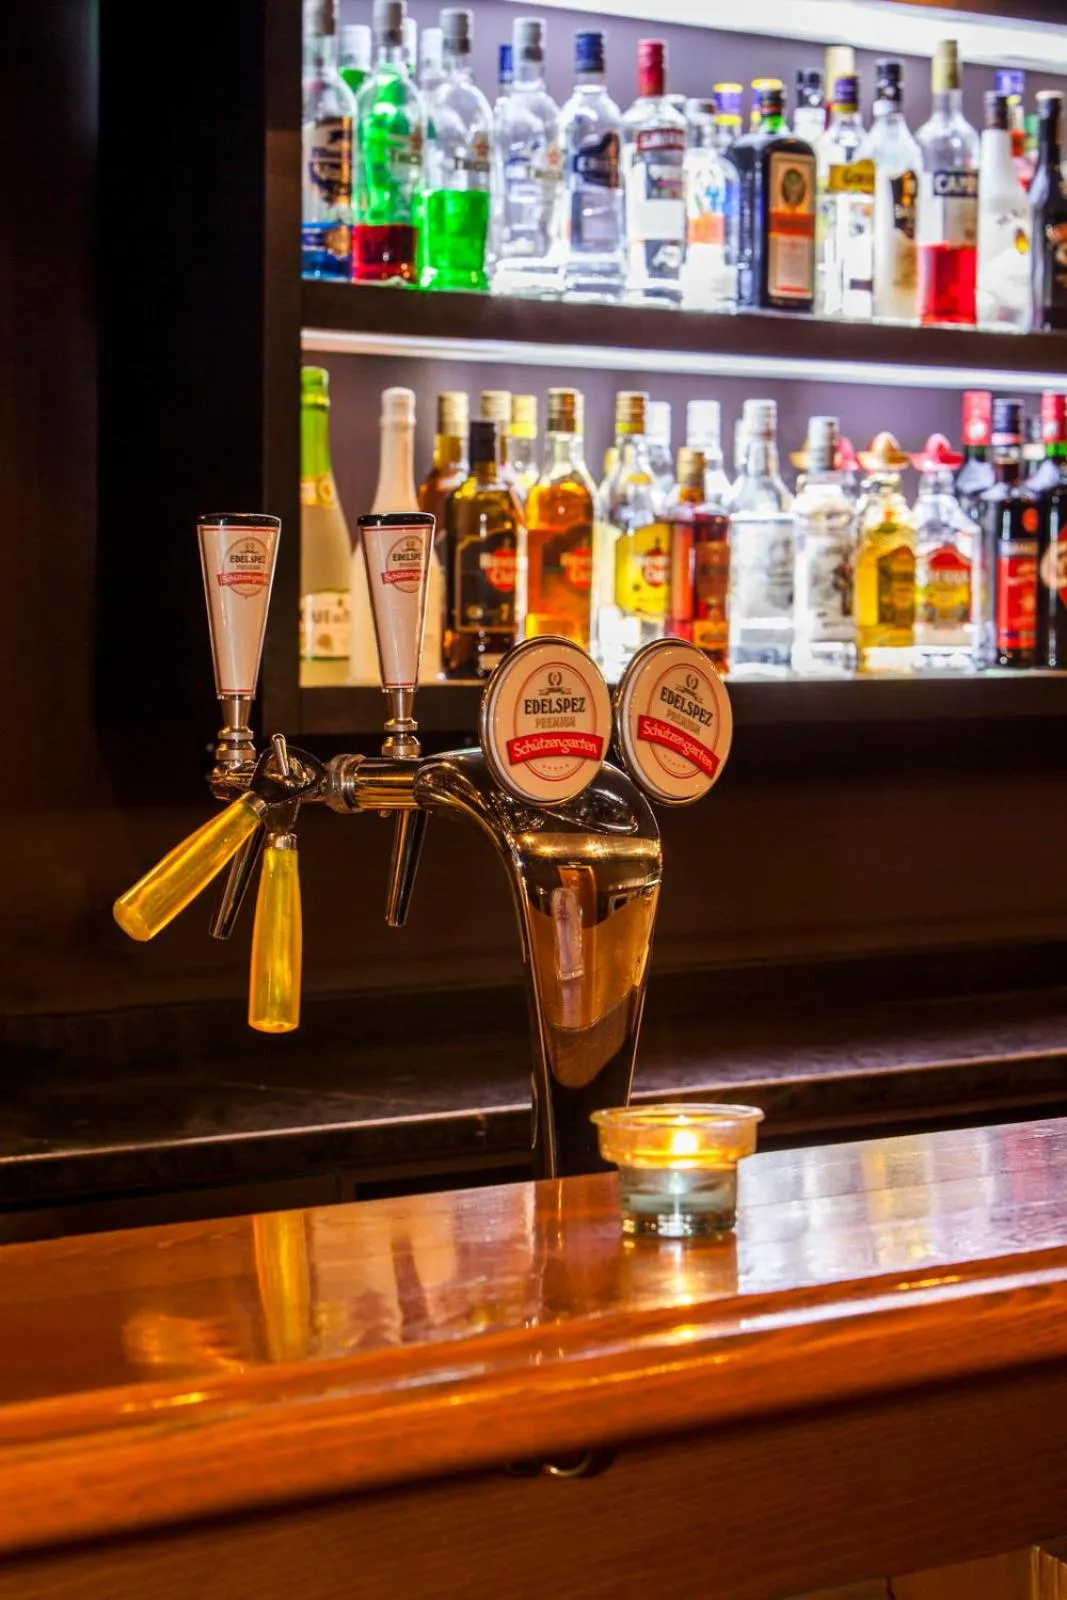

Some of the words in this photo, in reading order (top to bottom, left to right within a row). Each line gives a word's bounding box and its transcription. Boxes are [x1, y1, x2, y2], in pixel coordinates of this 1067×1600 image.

[524, 697, 586, 715] EDELSPEZ
[660, 686, 714, 727] EDELSPEZ
[535, 716, 576, 729] PREMIUM
[513, 737, 598, 757] Schützengarten
[643, 720, 714, 771] Schützengarten
